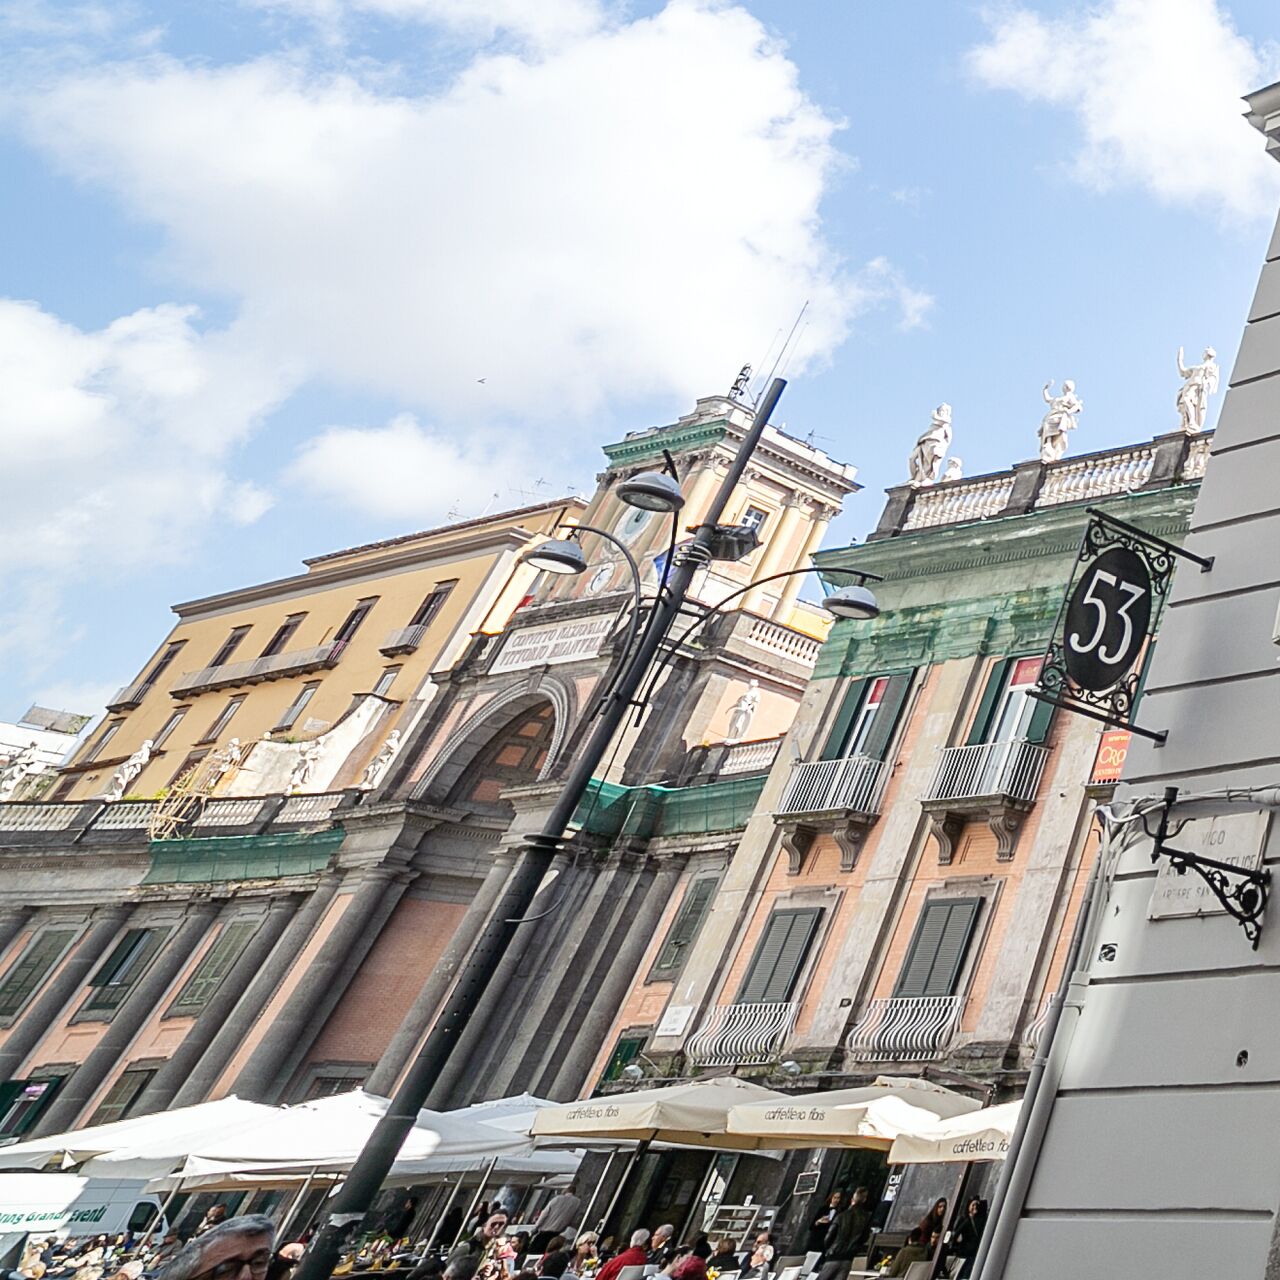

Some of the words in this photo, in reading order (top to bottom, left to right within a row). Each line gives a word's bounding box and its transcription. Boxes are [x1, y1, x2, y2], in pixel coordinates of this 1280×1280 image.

[1069, 569, 1146, 665] 53
[0, 1212, 26, 1225] ring
[25, 1208, 68, 1222] Grandi
